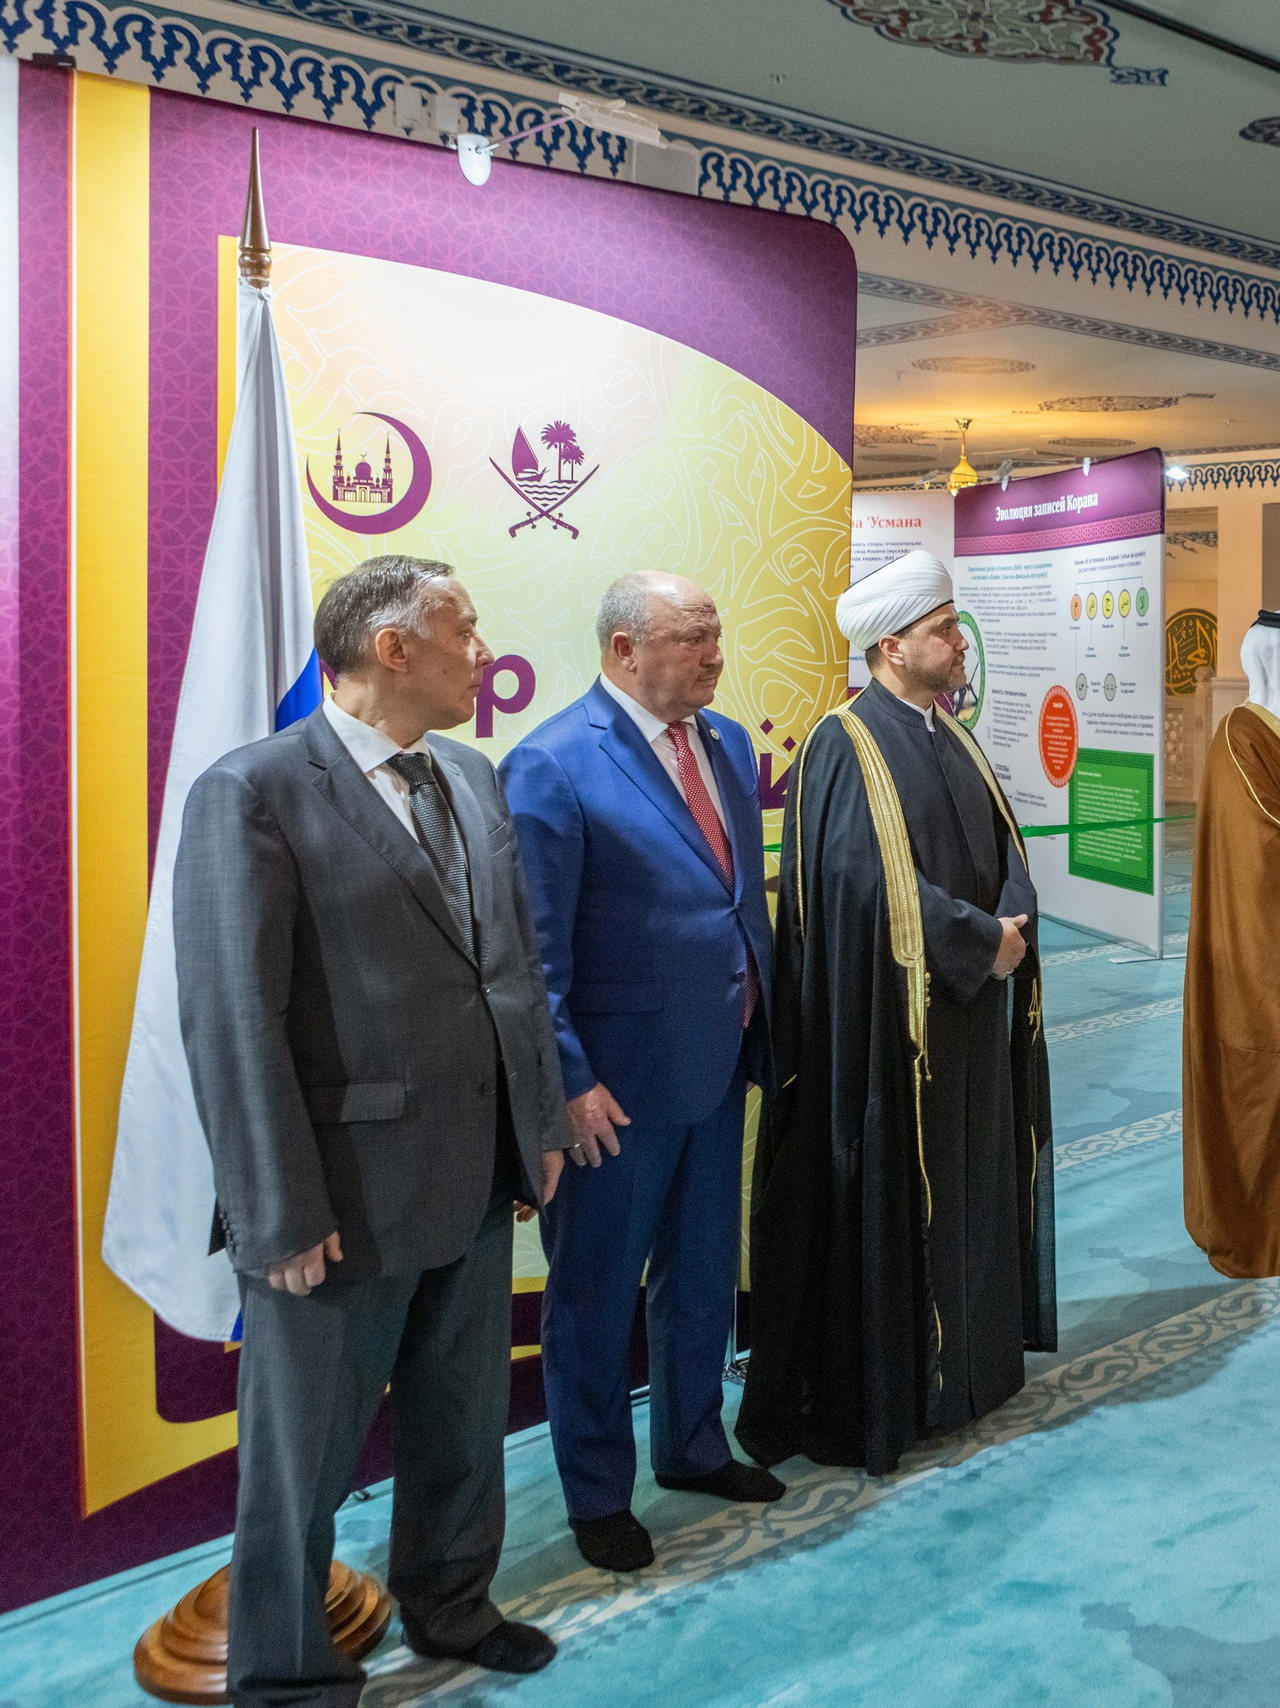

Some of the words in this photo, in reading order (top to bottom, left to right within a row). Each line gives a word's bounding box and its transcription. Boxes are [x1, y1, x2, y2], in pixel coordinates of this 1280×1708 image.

[995, 506, 1033, 522] Эволюция
[1034, 496, 1066, 517] записей
[1067, 493, 1098, 513] Корана
